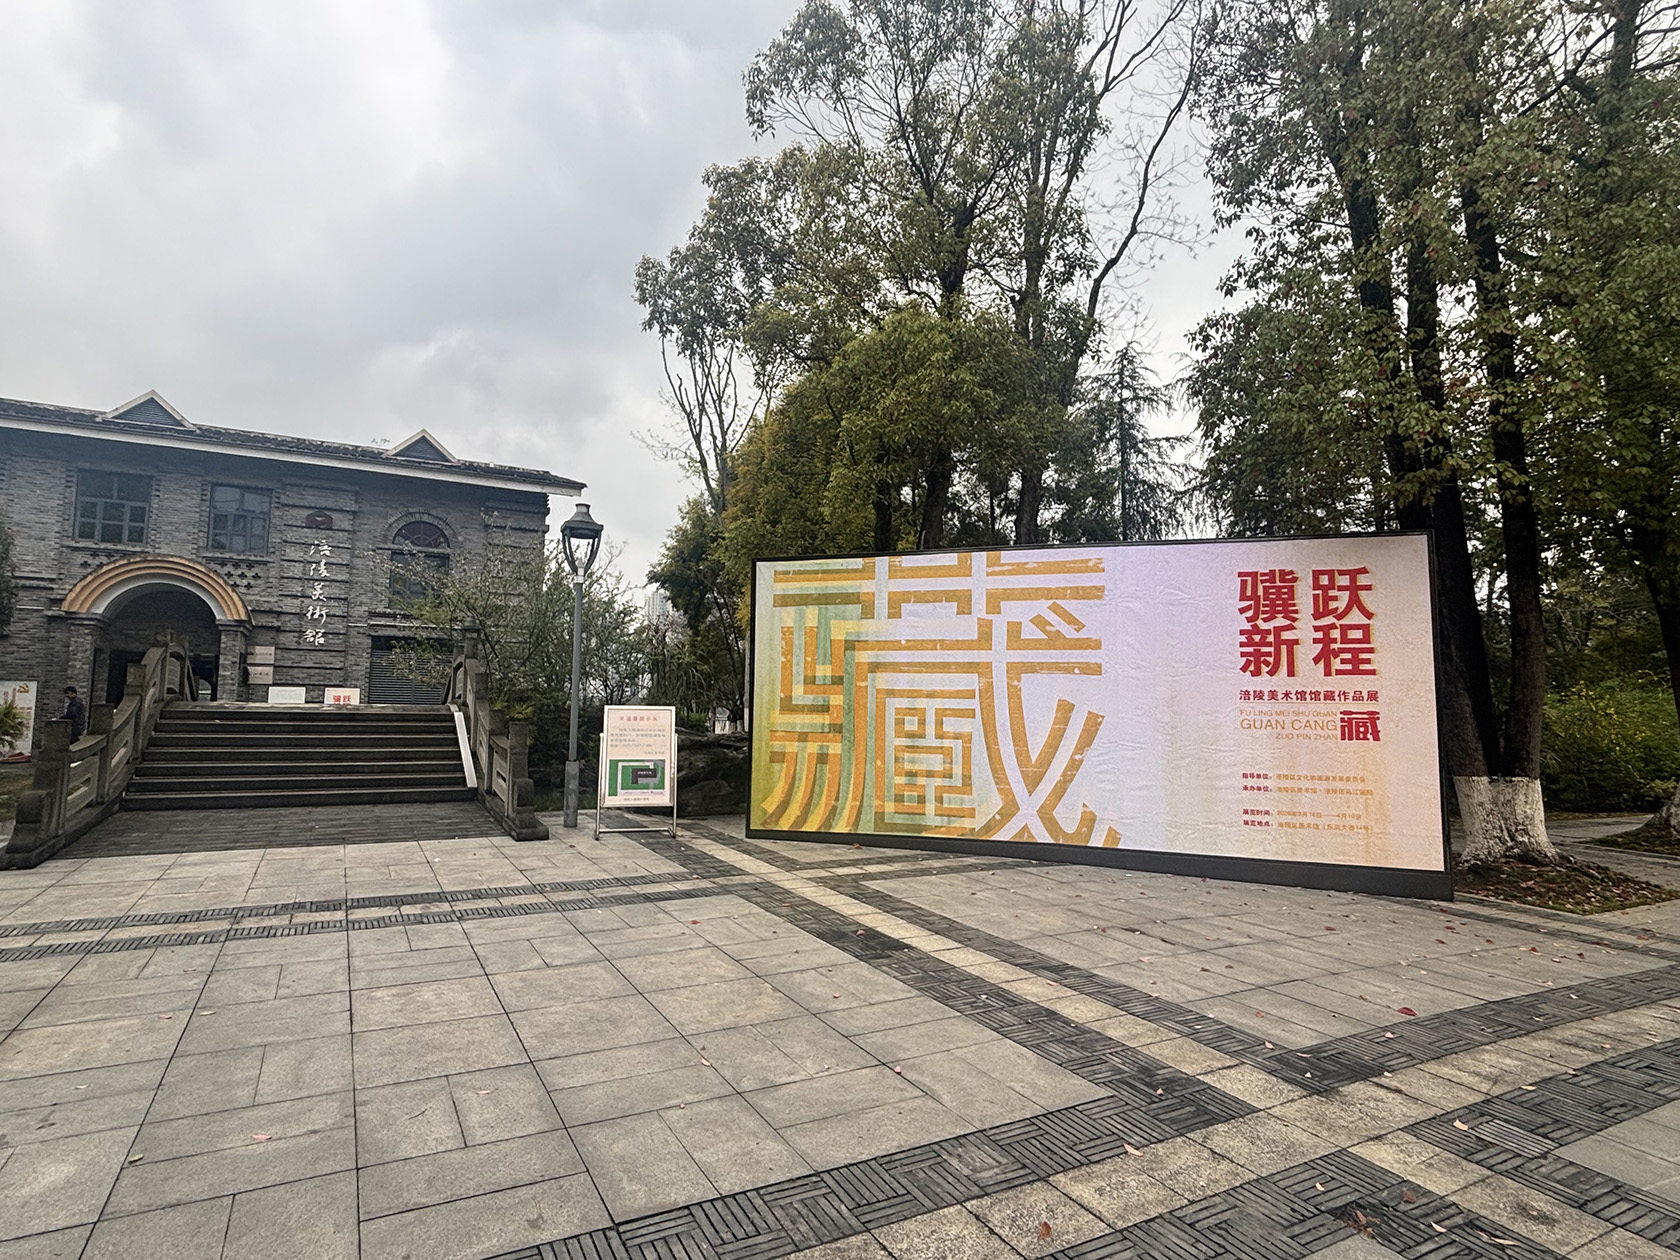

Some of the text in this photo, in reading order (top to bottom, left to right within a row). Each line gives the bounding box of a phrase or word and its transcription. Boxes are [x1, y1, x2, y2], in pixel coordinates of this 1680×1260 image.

[304, 540, 332, 646] 涪陵美術館
[1238, 566, 1375, 623] 骥跃
[1239, 622, 1377, 678] 新程
[1239, 689, 1380, 703] 涪陵美术馆馆藏作品展
[1240, 709, 1251, 717] FU
[1275, 710, 1290, 718] MEI
[1292, 710, 1311, 718] SHU
[1313, 710, 1338, 718] GUAN
[1240, 718, 1338, 732] GUAN CANG
[1275, 733, 1339, 741] ZUO PIN ZHAN
[1340, 710, 1381, 742] 藏
